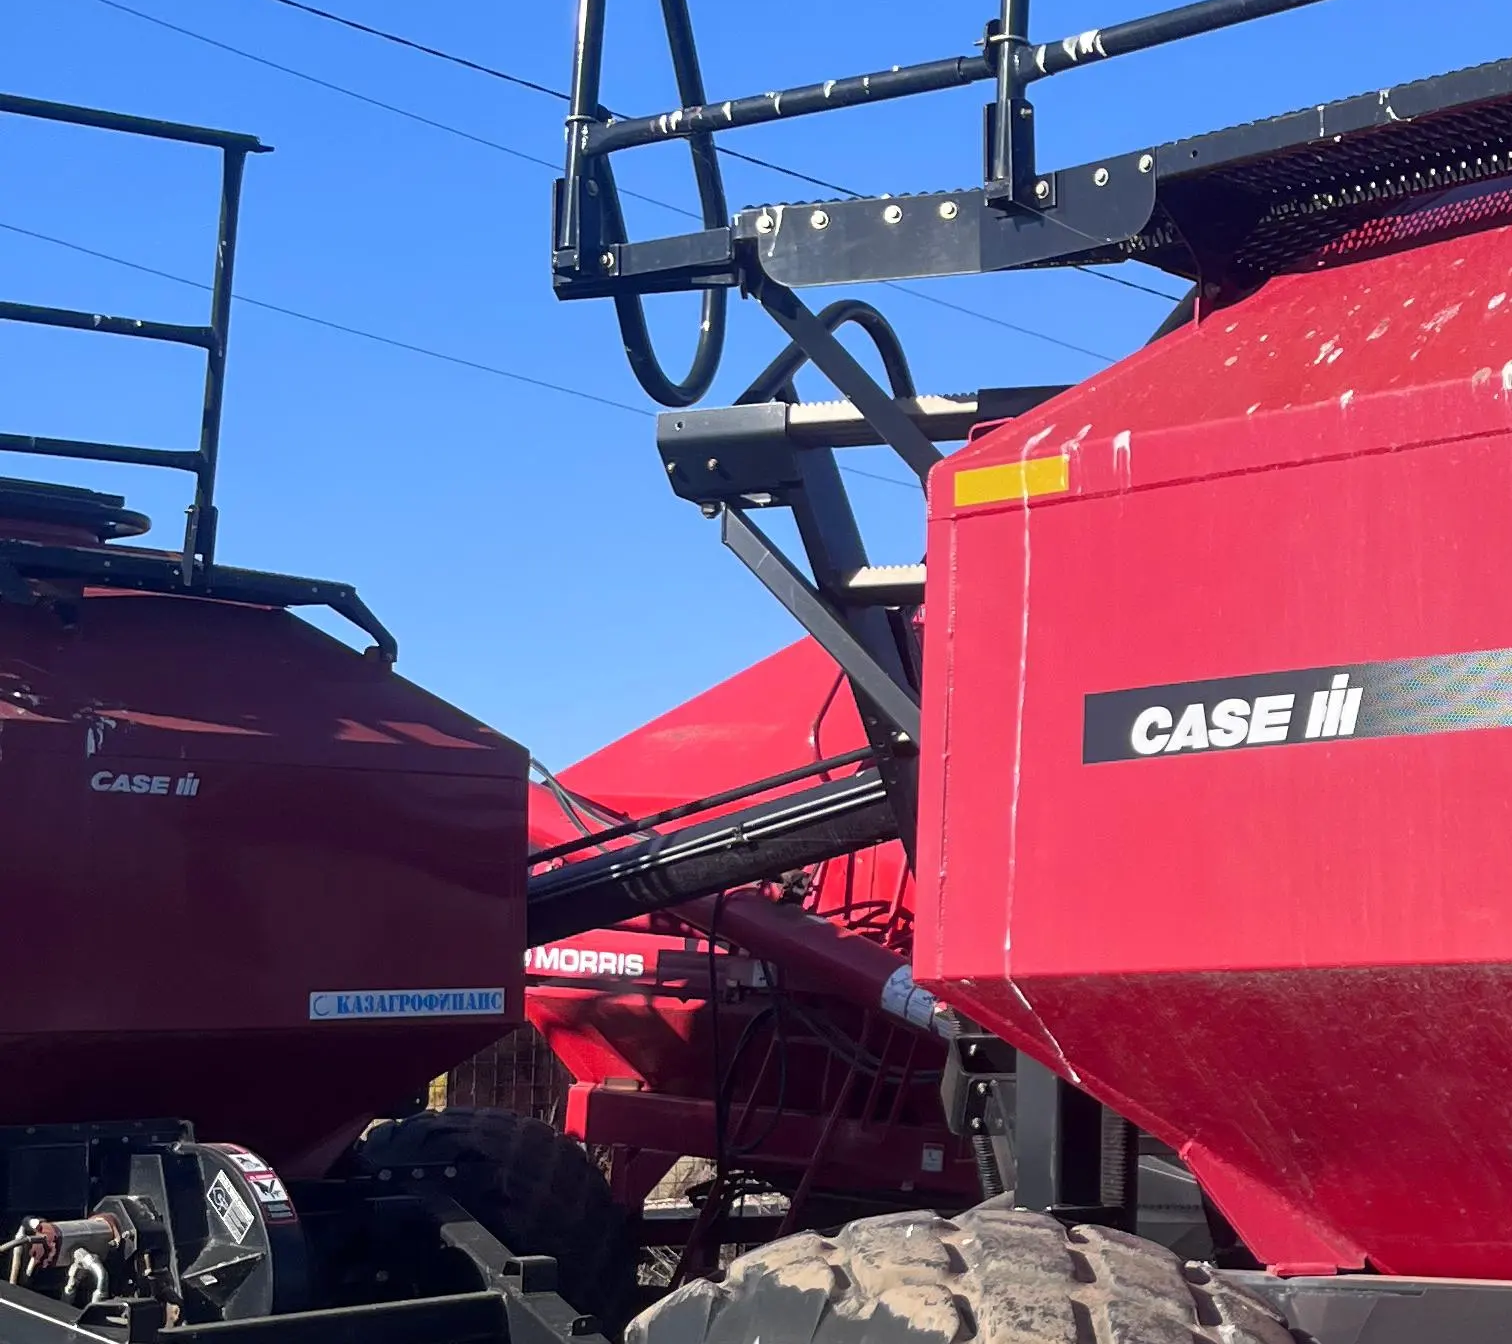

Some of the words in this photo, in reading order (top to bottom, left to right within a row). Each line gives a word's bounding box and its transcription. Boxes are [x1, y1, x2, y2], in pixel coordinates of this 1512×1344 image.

[1131, 697, 1296, 755] CASE
[91, 770, 171, 794] CASE
[535, 947, 644, 977] MORRIS
